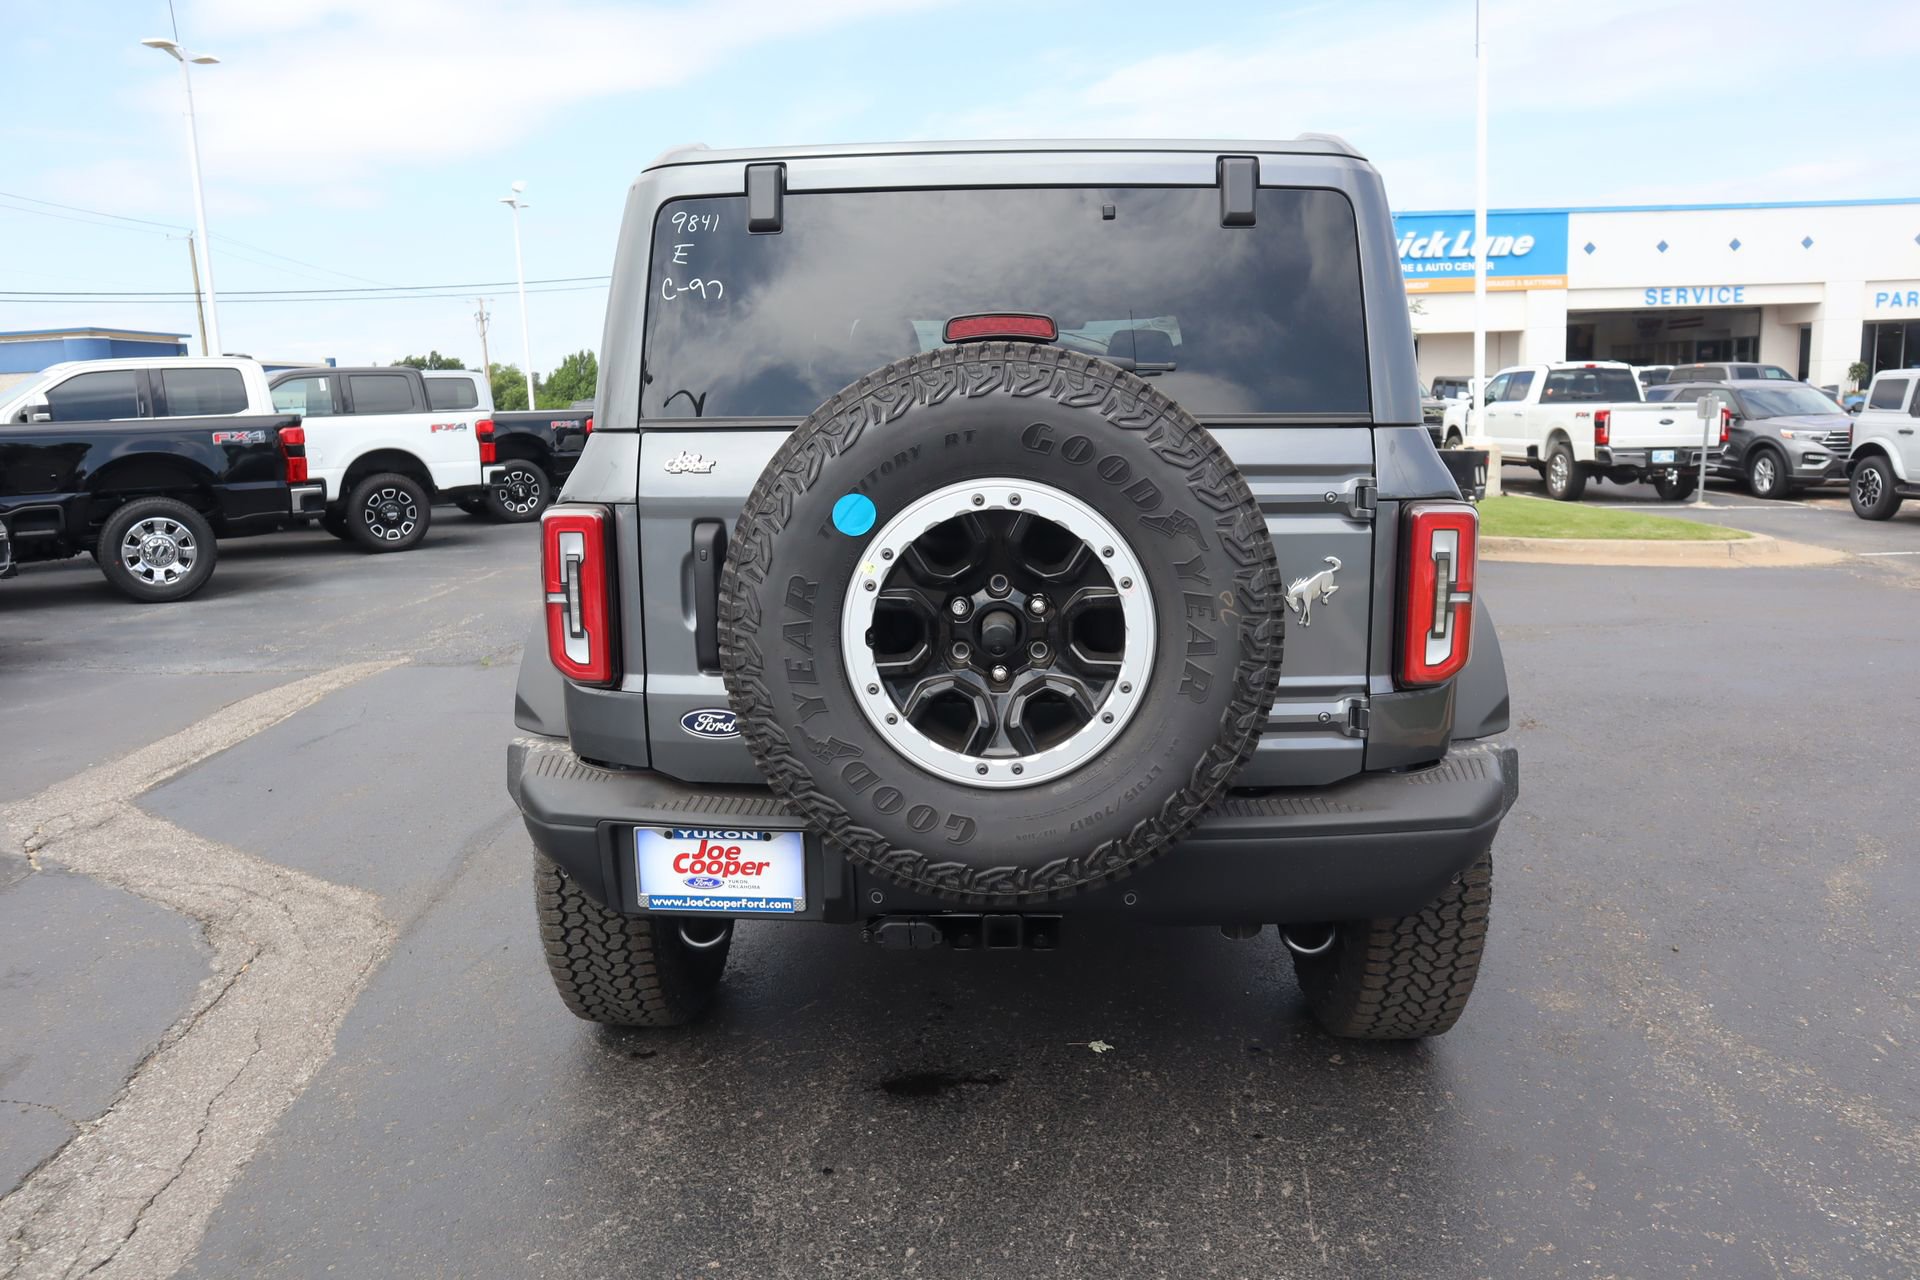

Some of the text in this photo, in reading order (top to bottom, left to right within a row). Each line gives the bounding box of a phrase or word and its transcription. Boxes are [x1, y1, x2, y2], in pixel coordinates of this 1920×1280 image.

[671, 211, 720, 234] 9841
[672, 243, 695, 265] E
[1425, 262, 1453, 272] AUTO
[1645, 286, 1745, 305] SERVICE
[431, 422, 467, 433] FX4
[212, 430, 266, 445] FX4
[694, 713, 737, 732] Ford
[678, 829, 758, 840] YUKON
[691, 839, 742, 861] Joe
[673, 852, 770, 878] Cooper
[693, 877, 714, 887] Ford
[651, 897, 792, 910] www.JoeCooperFord.com
